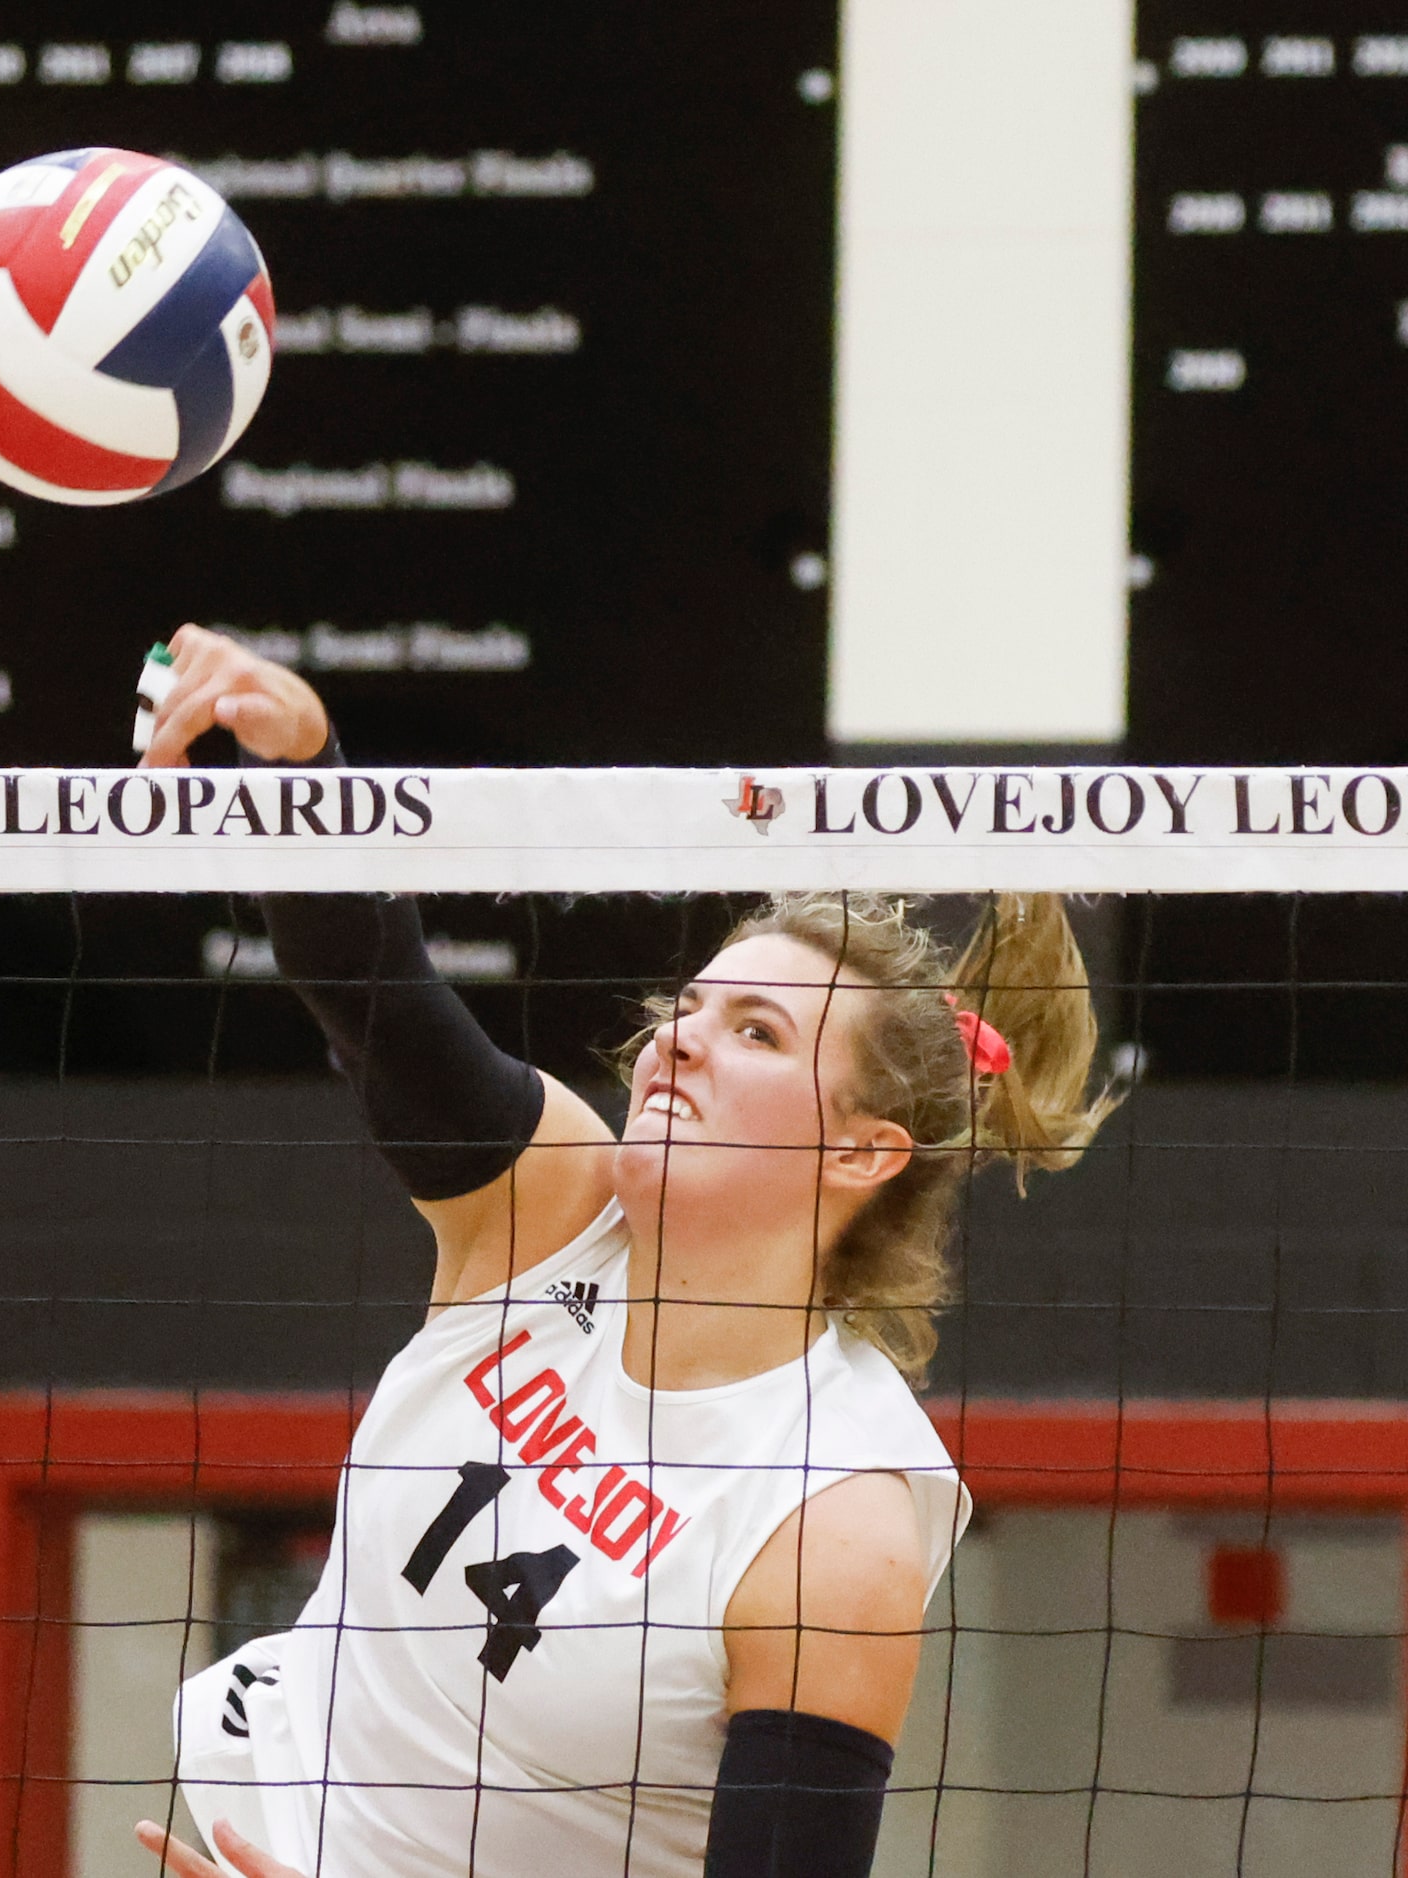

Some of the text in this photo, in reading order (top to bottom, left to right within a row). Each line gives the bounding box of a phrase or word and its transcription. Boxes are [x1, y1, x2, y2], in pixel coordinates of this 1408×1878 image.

[807, 773, 1206, 835] LOVEJOY
[463, 1329, 693, 1579] LOVEJOY
[401, 1461, 581, 1684] 14
